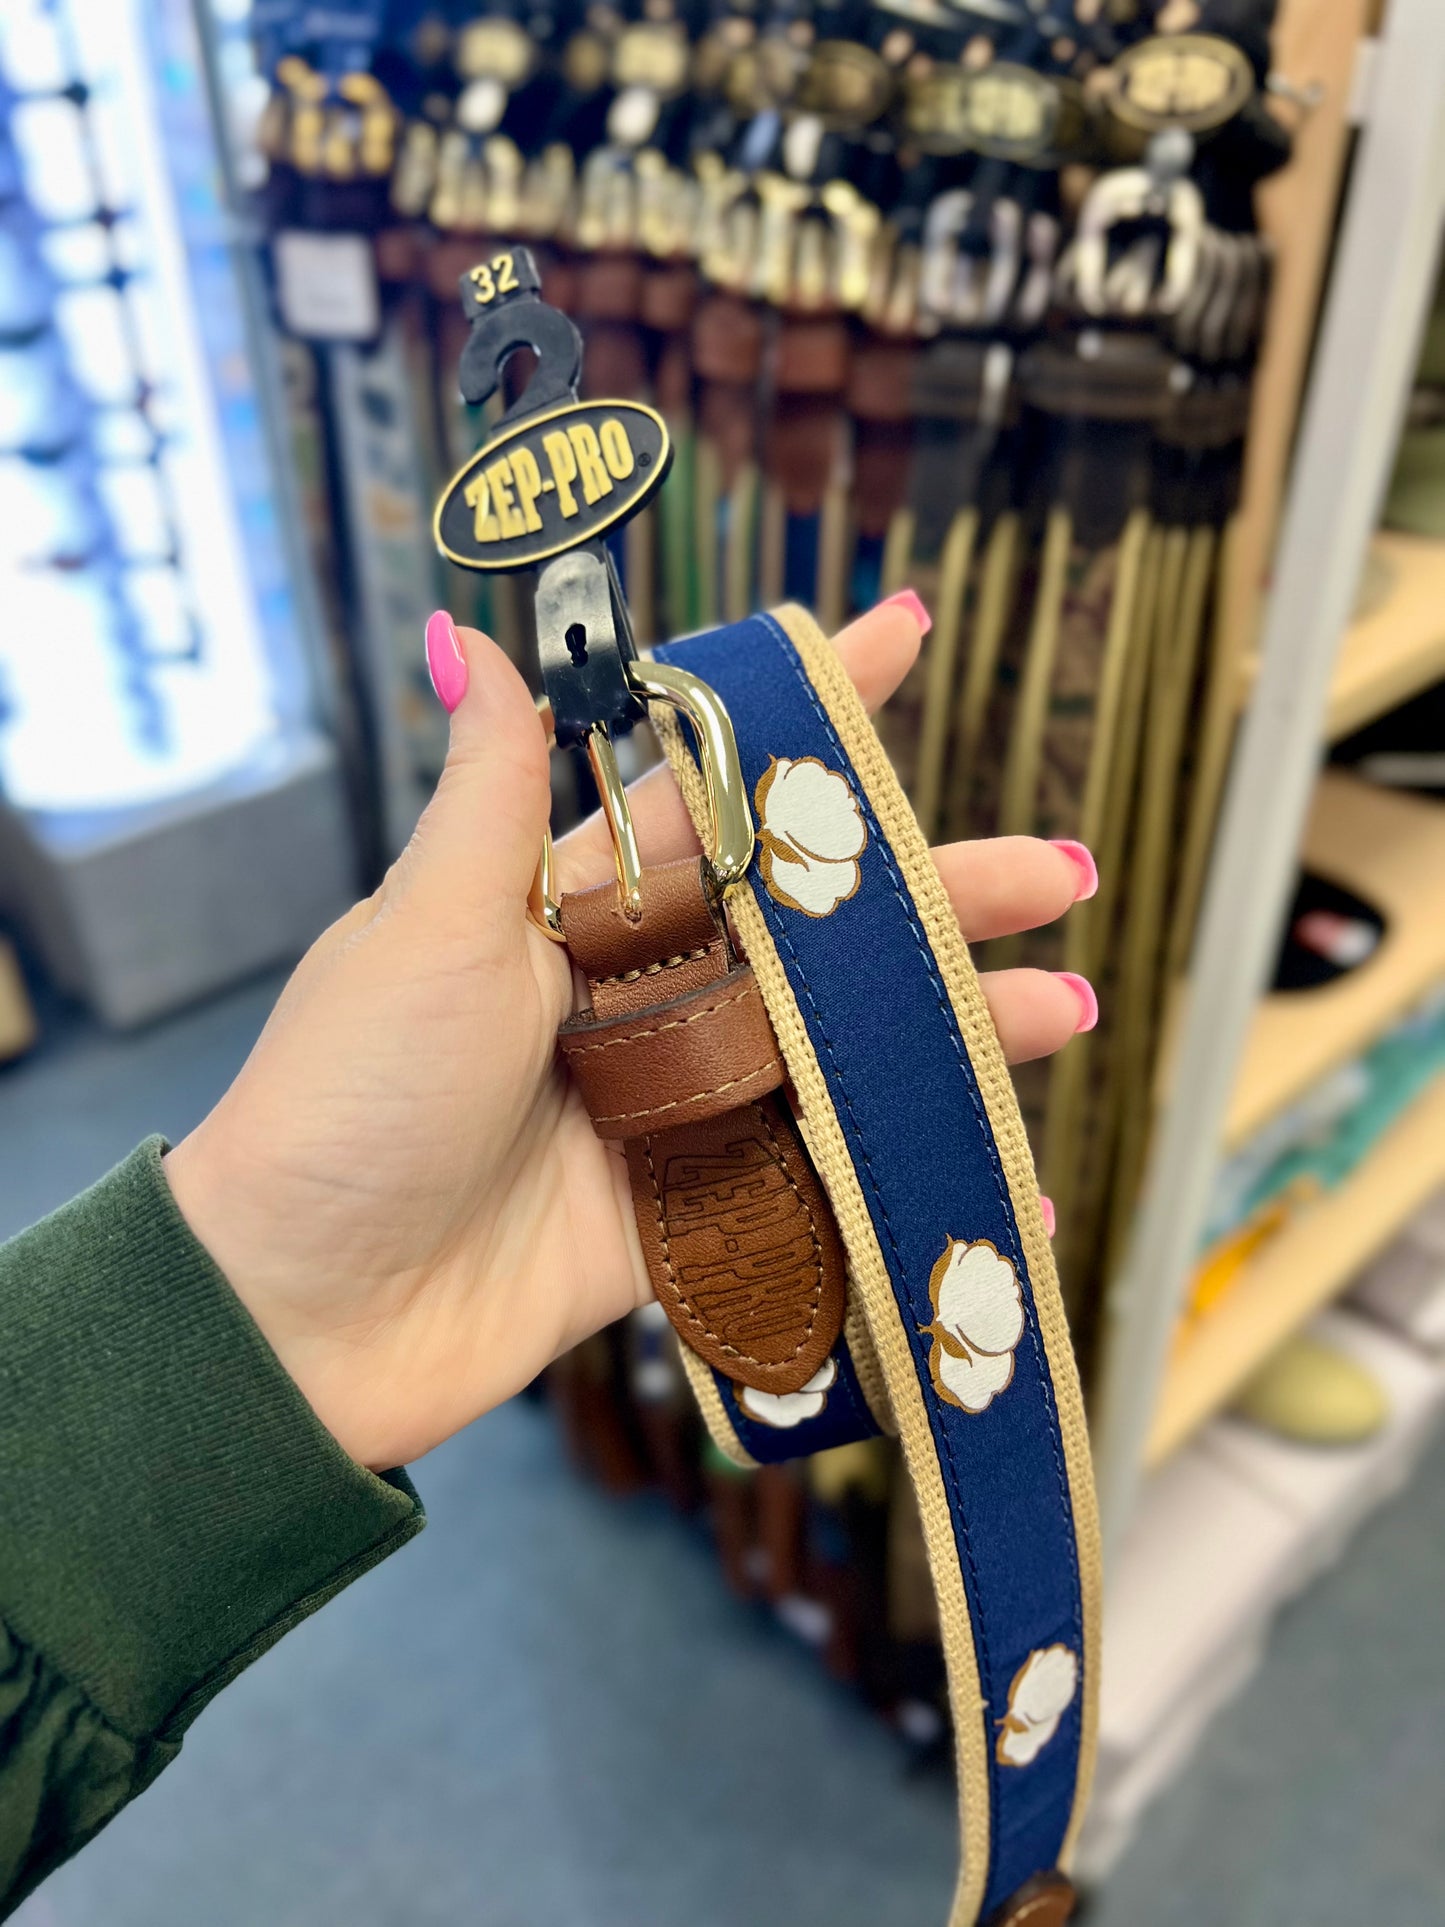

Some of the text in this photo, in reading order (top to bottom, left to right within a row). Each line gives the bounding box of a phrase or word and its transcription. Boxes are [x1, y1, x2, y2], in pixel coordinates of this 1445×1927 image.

[470, 254, 519, 303] 32
[464, 419, 634, 543] ZEP-PRO
[663, 1136, 822, 1343] ZEP-PRO
